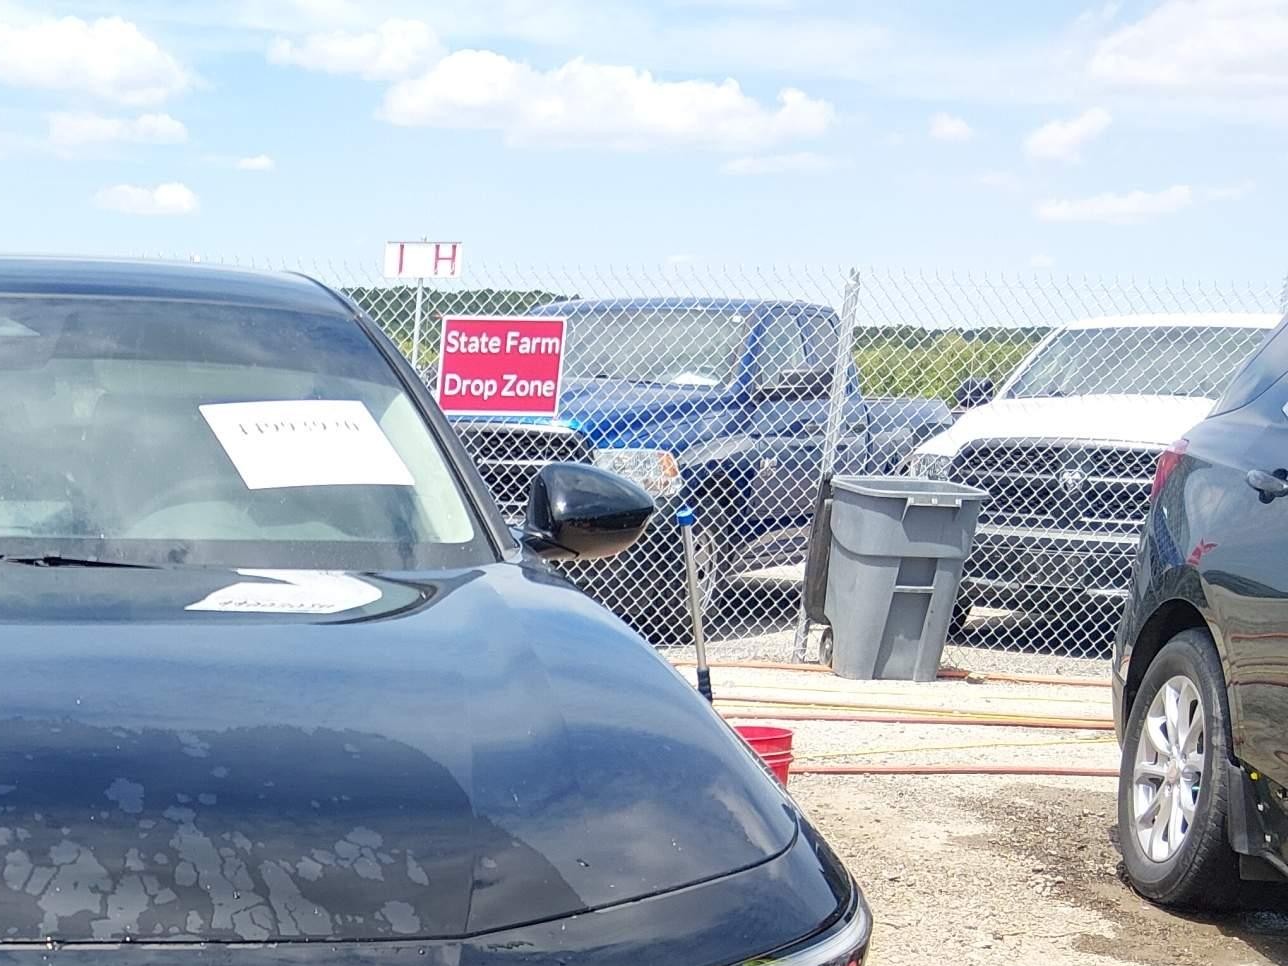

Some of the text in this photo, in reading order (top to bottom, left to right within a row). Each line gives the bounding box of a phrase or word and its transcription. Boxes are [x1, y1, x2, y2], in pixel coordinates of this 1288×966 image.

[446, 330, 560, 354] State Farm
[444, 373, 555, 400] Drop Zone
